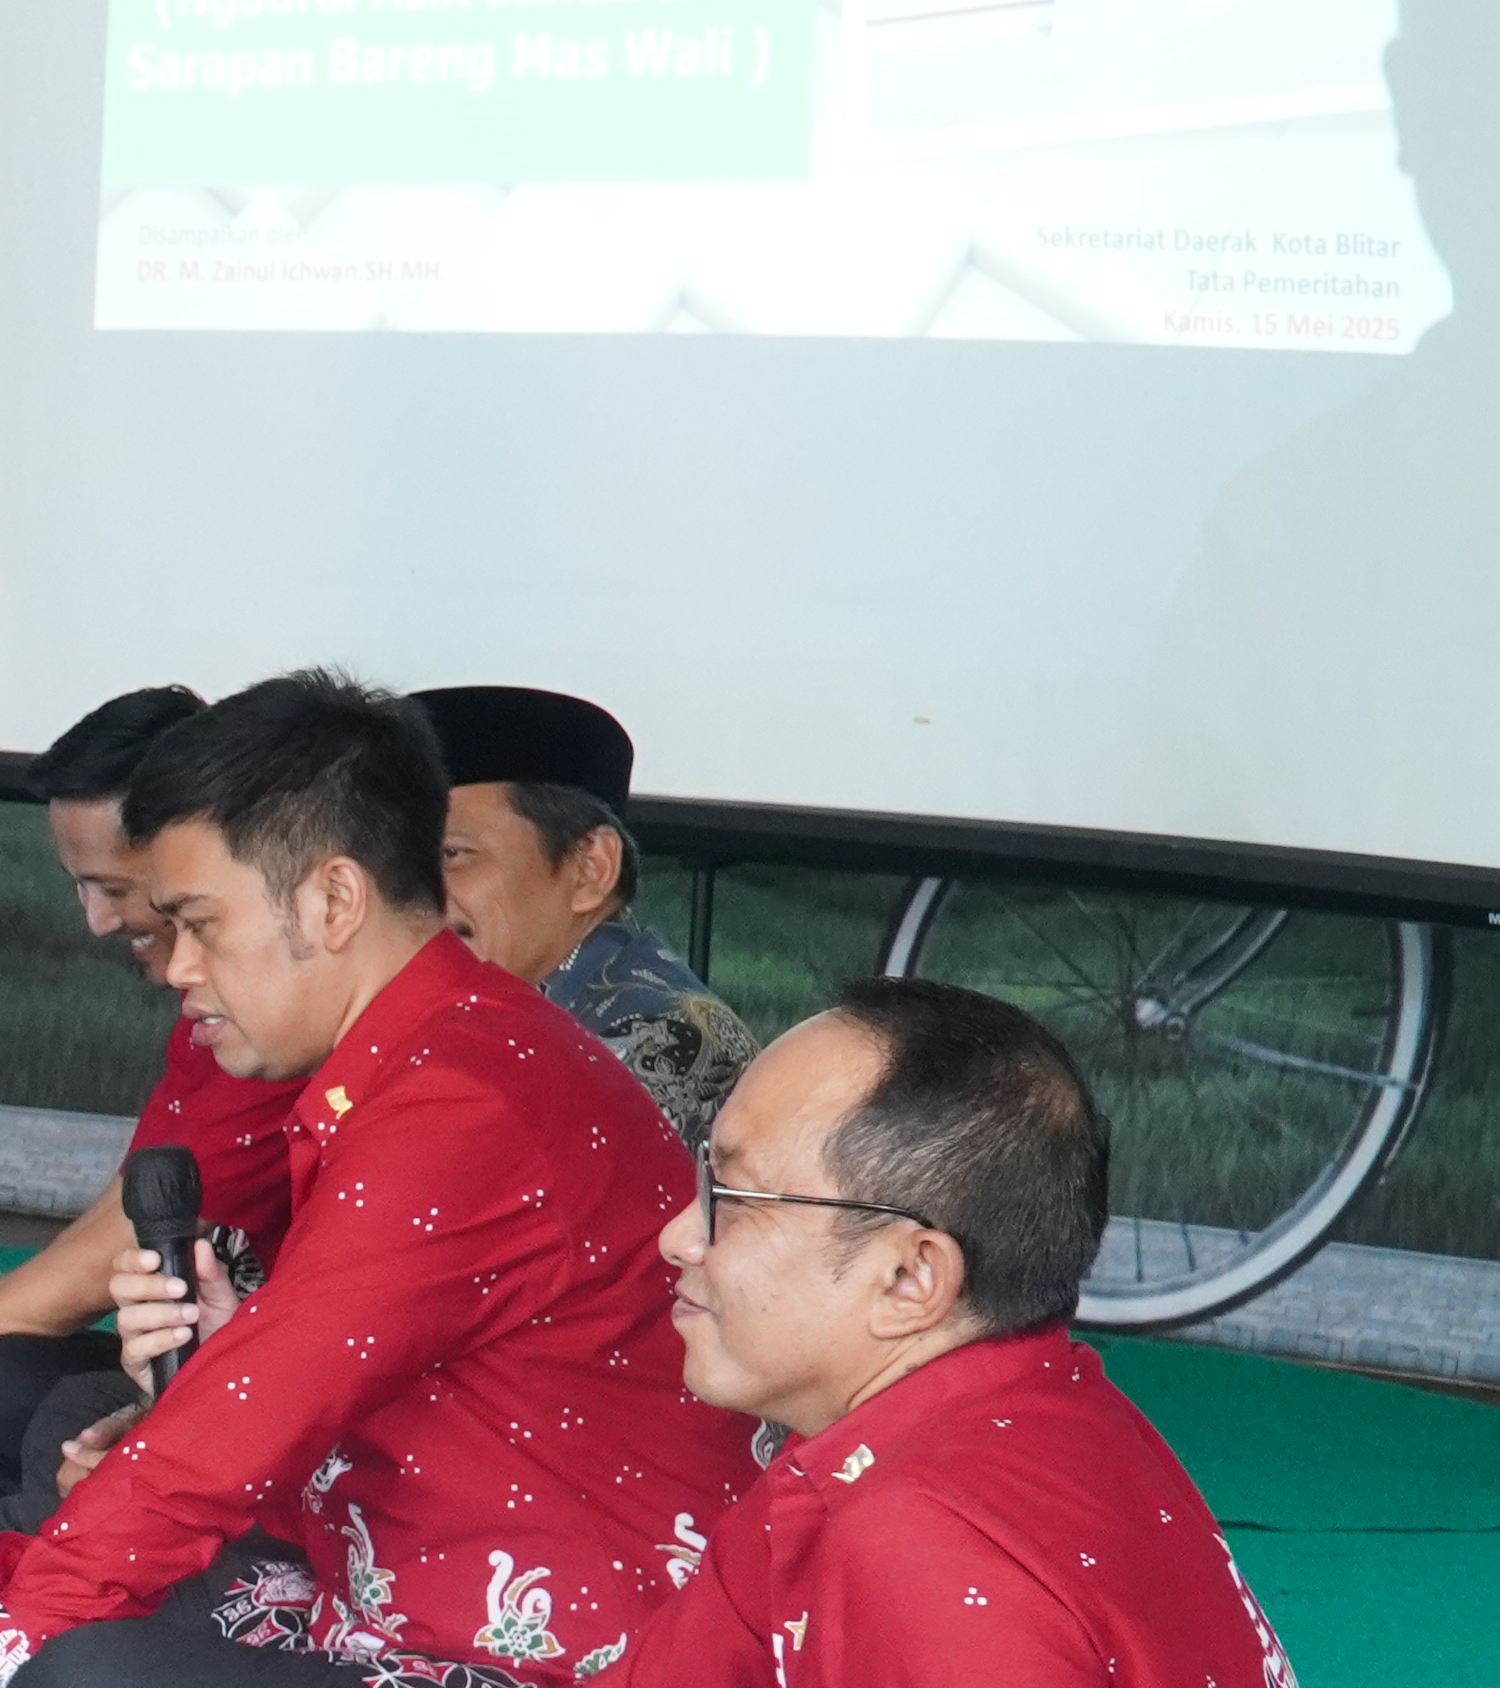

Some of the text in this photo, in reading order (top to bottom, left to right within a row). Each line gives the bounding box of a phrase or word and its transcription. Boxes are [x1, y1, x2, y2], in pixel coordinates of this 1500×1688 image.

[128, 42, 313, 96] Sarapan
[329, 37, 496, 90] Bareng
[510, 33, 608, 80] Mas
[625, 28, 733, 77] Wali
[138, 223, 261, 249] Disampaikan
[1036, 224, 1166, 252] Sekretariat
[1272, 231, 1328, 257] Kota
[1336, 232, 1400, 260] Blitar
[136, 259, 172, 283] DR.
[177, 260, 206, 283] M.
[212, 260, 275, 283] Zainul
[1186, 267, 1400, 300] Tata Pemeritahan
[1162, 309, 1400, 341] Kamis, 15 Mei 2025
